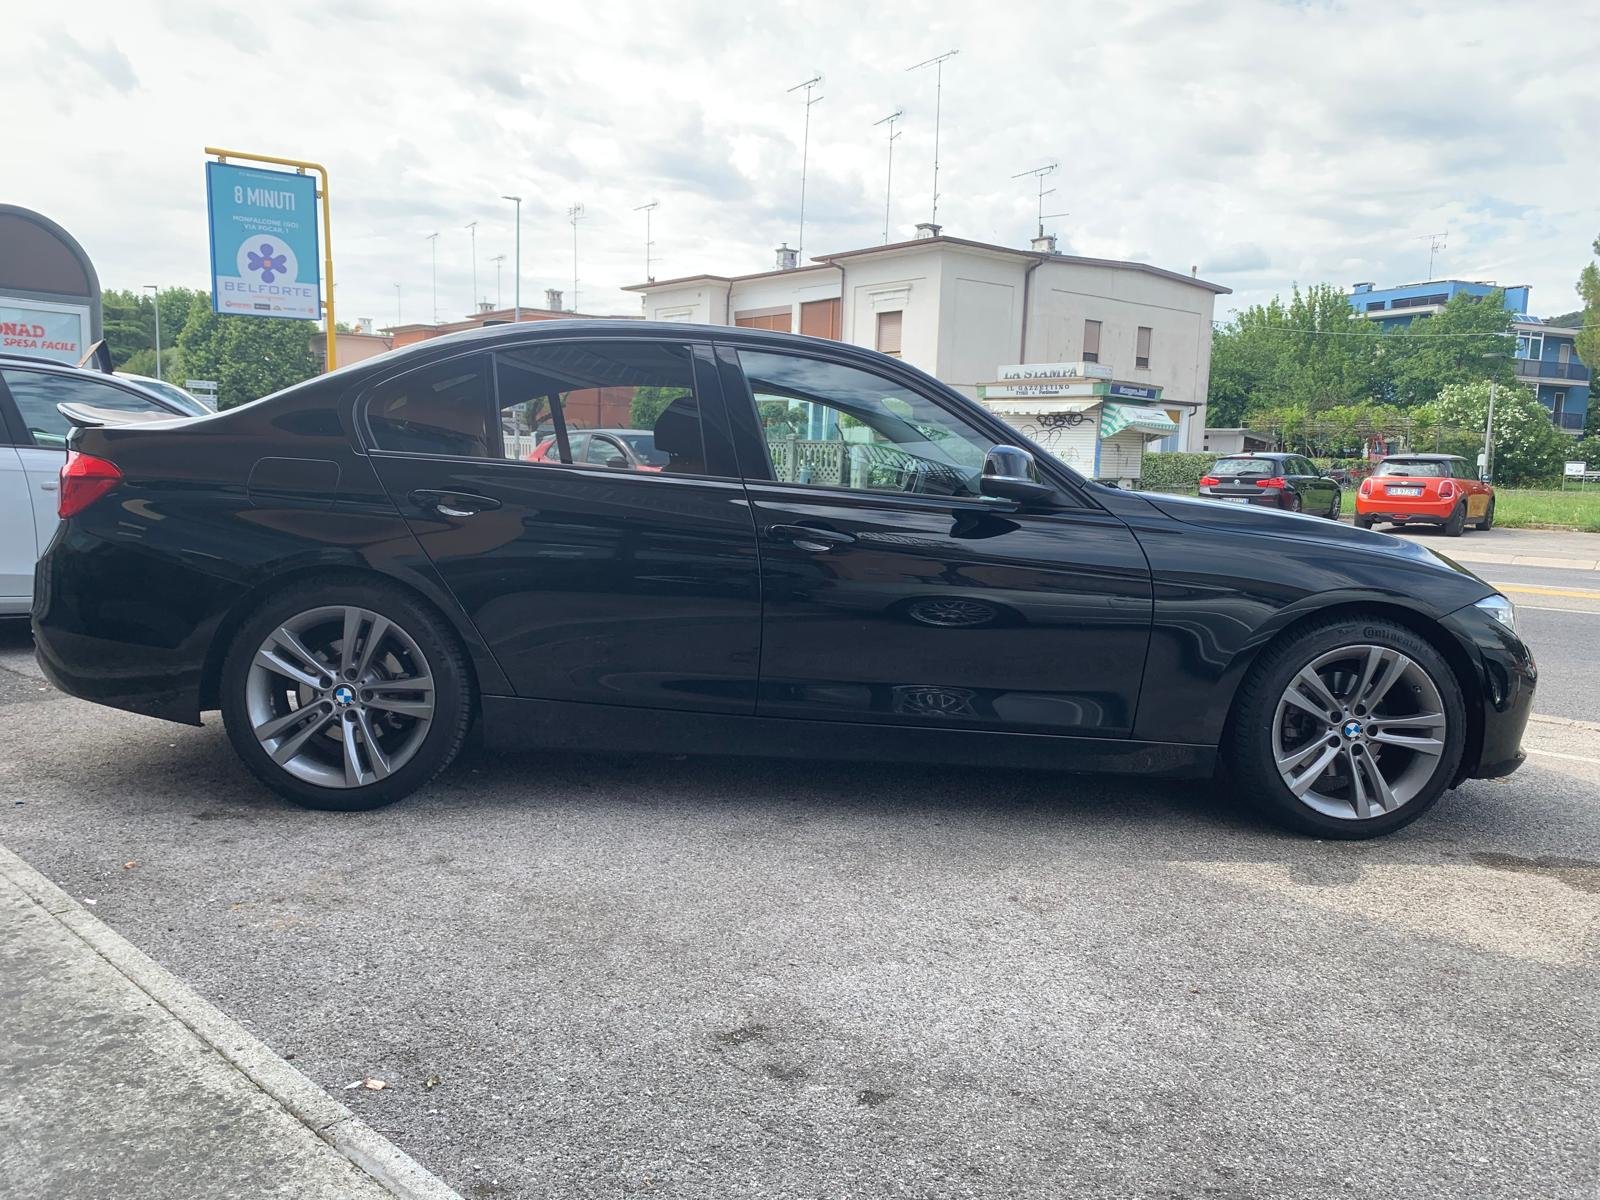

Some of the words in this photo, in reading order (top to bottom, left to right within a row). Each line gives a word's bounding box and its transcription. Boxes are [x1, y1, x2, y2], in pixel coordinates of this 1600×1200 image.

[234, 185, 243, 204] 8
[247, 186, 296, 211] MINUTI
[232, 215, 281, 227] MONFALCONE
[243, 223, 257, 231] VIA
[224, 281, 313, 298] BELFORTE
[3, 337, 37, 348] SPESA
[41, 340, 78, 352] FACILE
[1004, 371, 1021, 380] LA
[1023, 367, 1078, 379] STAMPA
[1363, 626, 1420, 651] Continental
